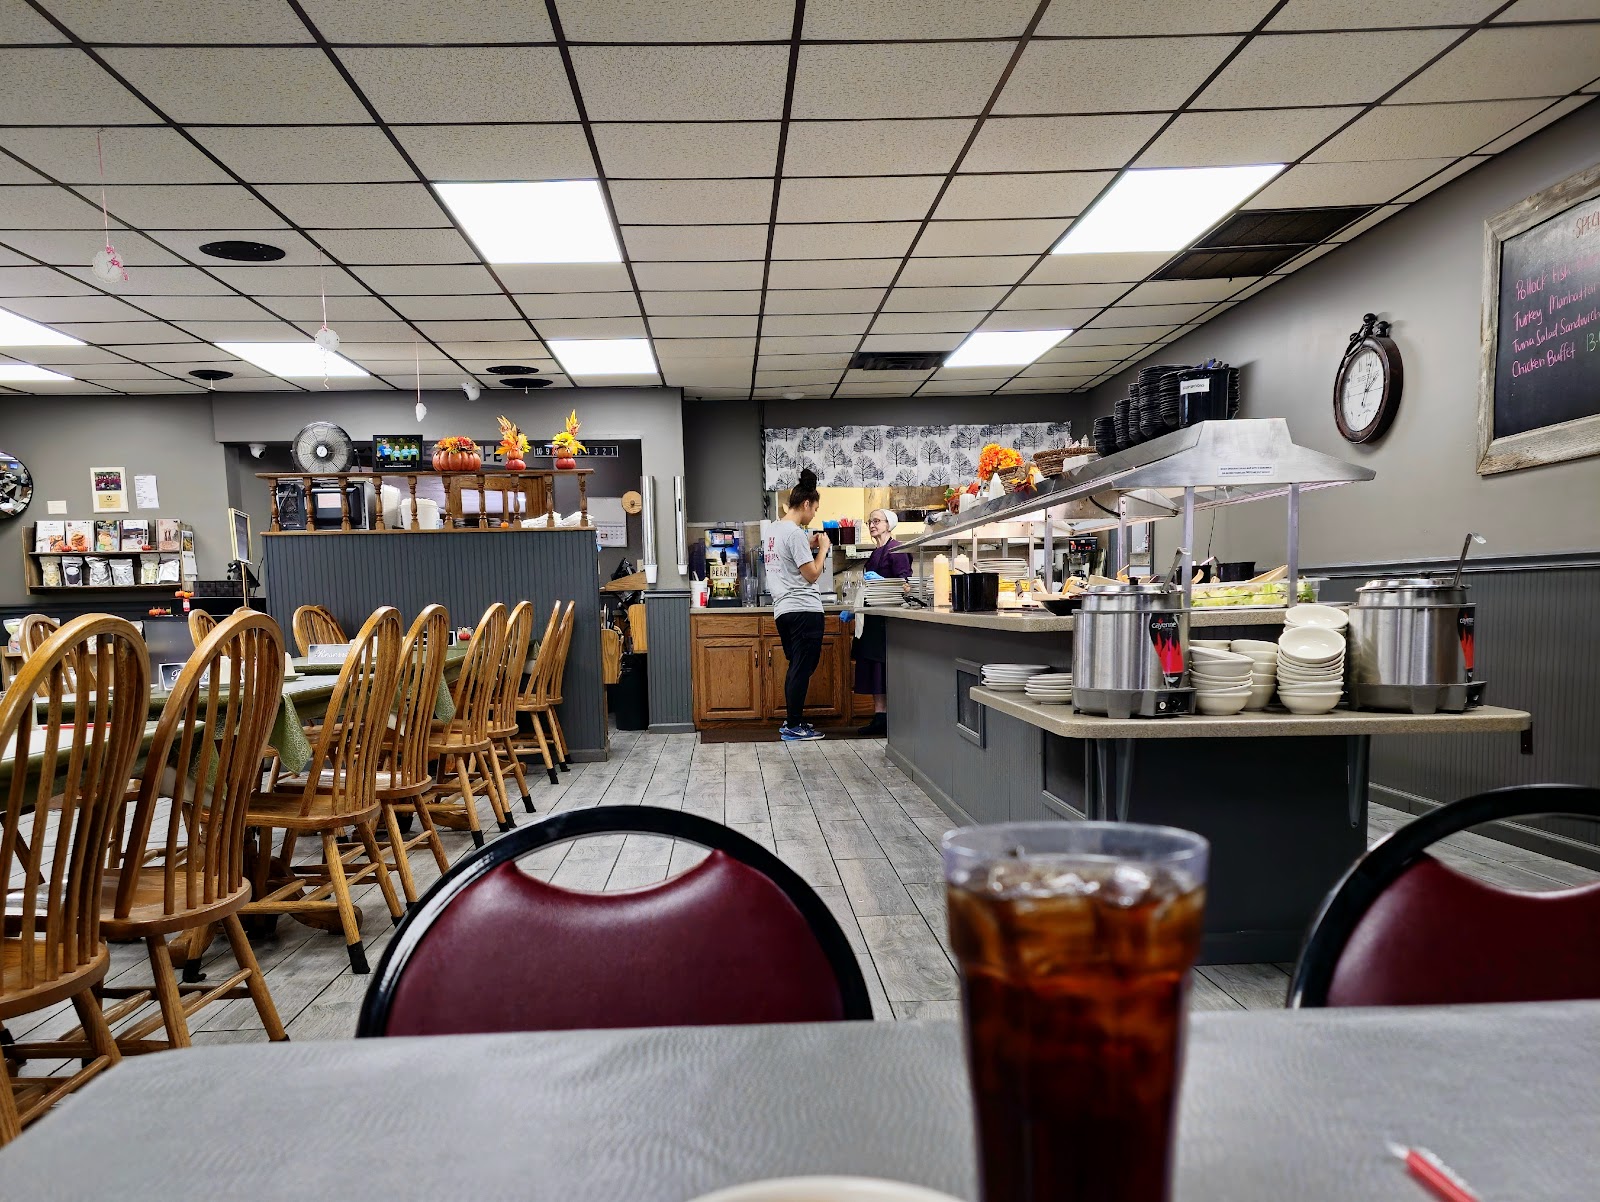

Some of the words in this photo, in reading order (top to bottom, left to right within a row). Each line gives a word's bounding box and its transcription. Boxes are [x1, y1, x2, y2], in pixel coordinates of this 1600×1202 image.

[1516, 272, 1548, 301] Pollock
[1513, 308, 1543, 332] Turkey
[1512, 337, 1535, 354] Tuna
[1536, 322, 1558, 347] Salad
[1512, 358, 1545, 378] Chicken
[1547, 342, 1576, 367] Buffet
[1151, 622, 1176, 630] cayenne
[315, 649, 347, 658] Reserv
